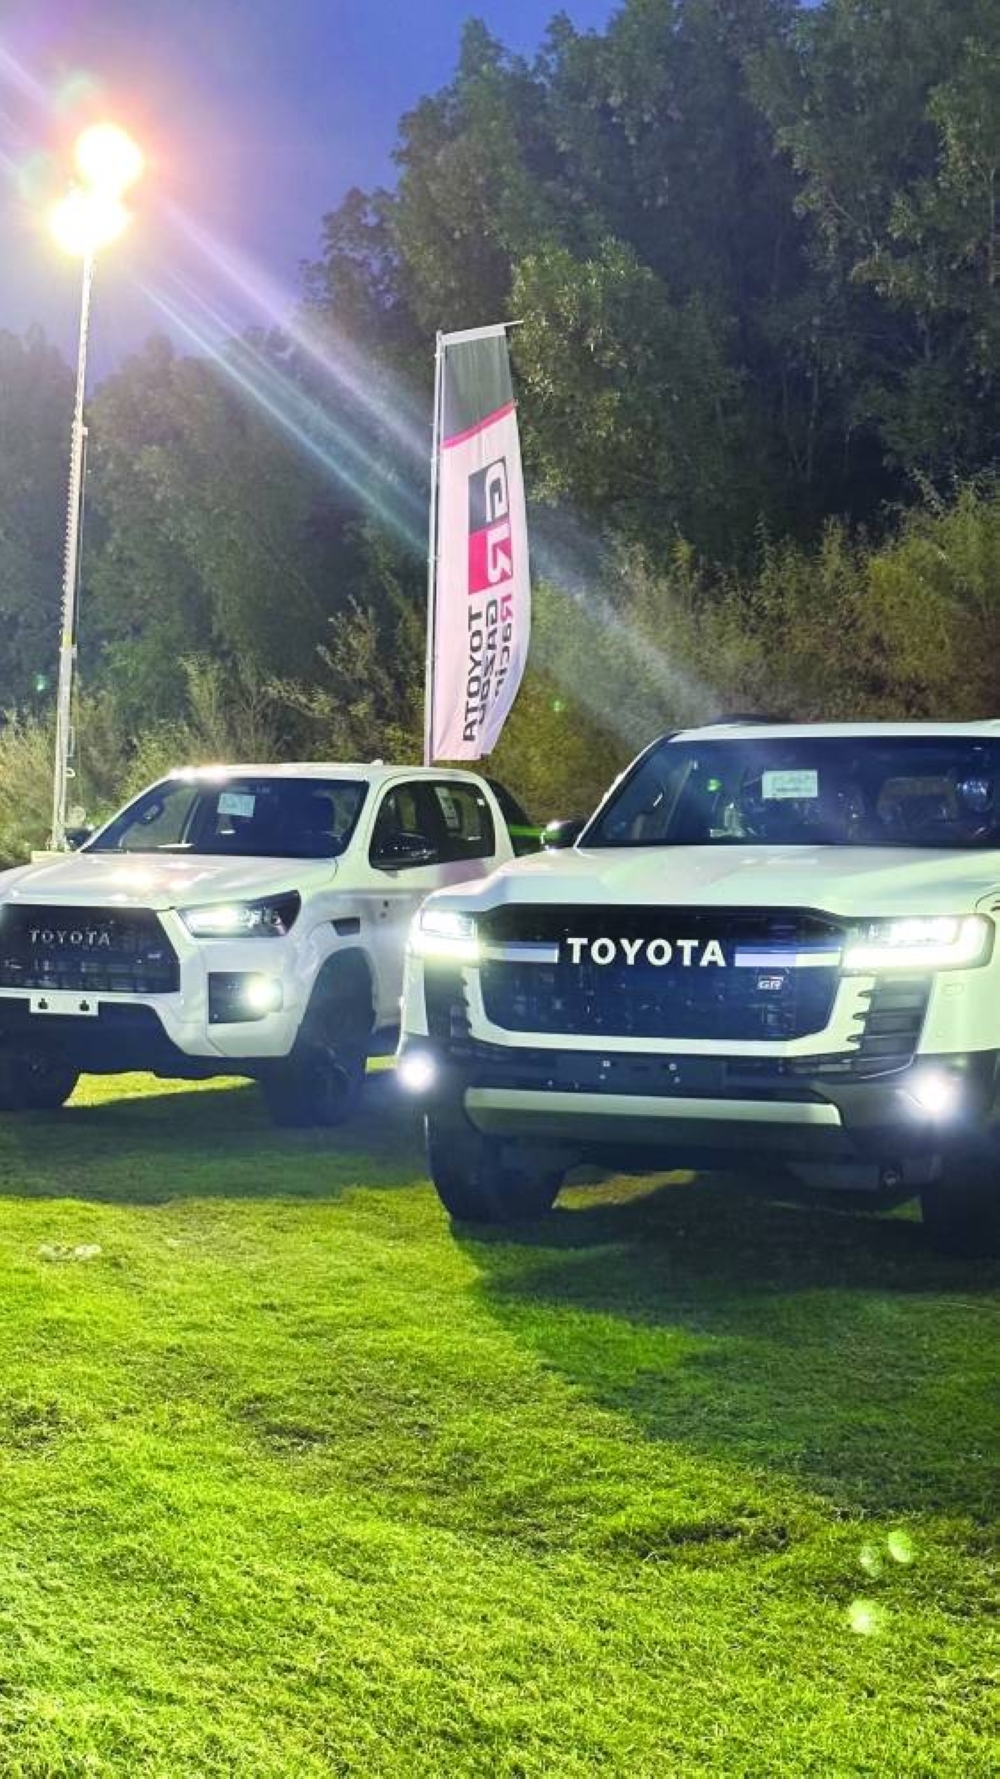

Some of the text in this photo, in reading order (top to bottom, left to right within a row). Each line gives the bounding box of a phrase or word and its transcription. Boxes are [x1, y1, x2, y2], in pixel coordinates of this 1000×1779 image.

[29, 929, 111, 947] TOYOTA
[566, 937, 726, 967] TOYOTA
[757, 978, 783, 990] GR
